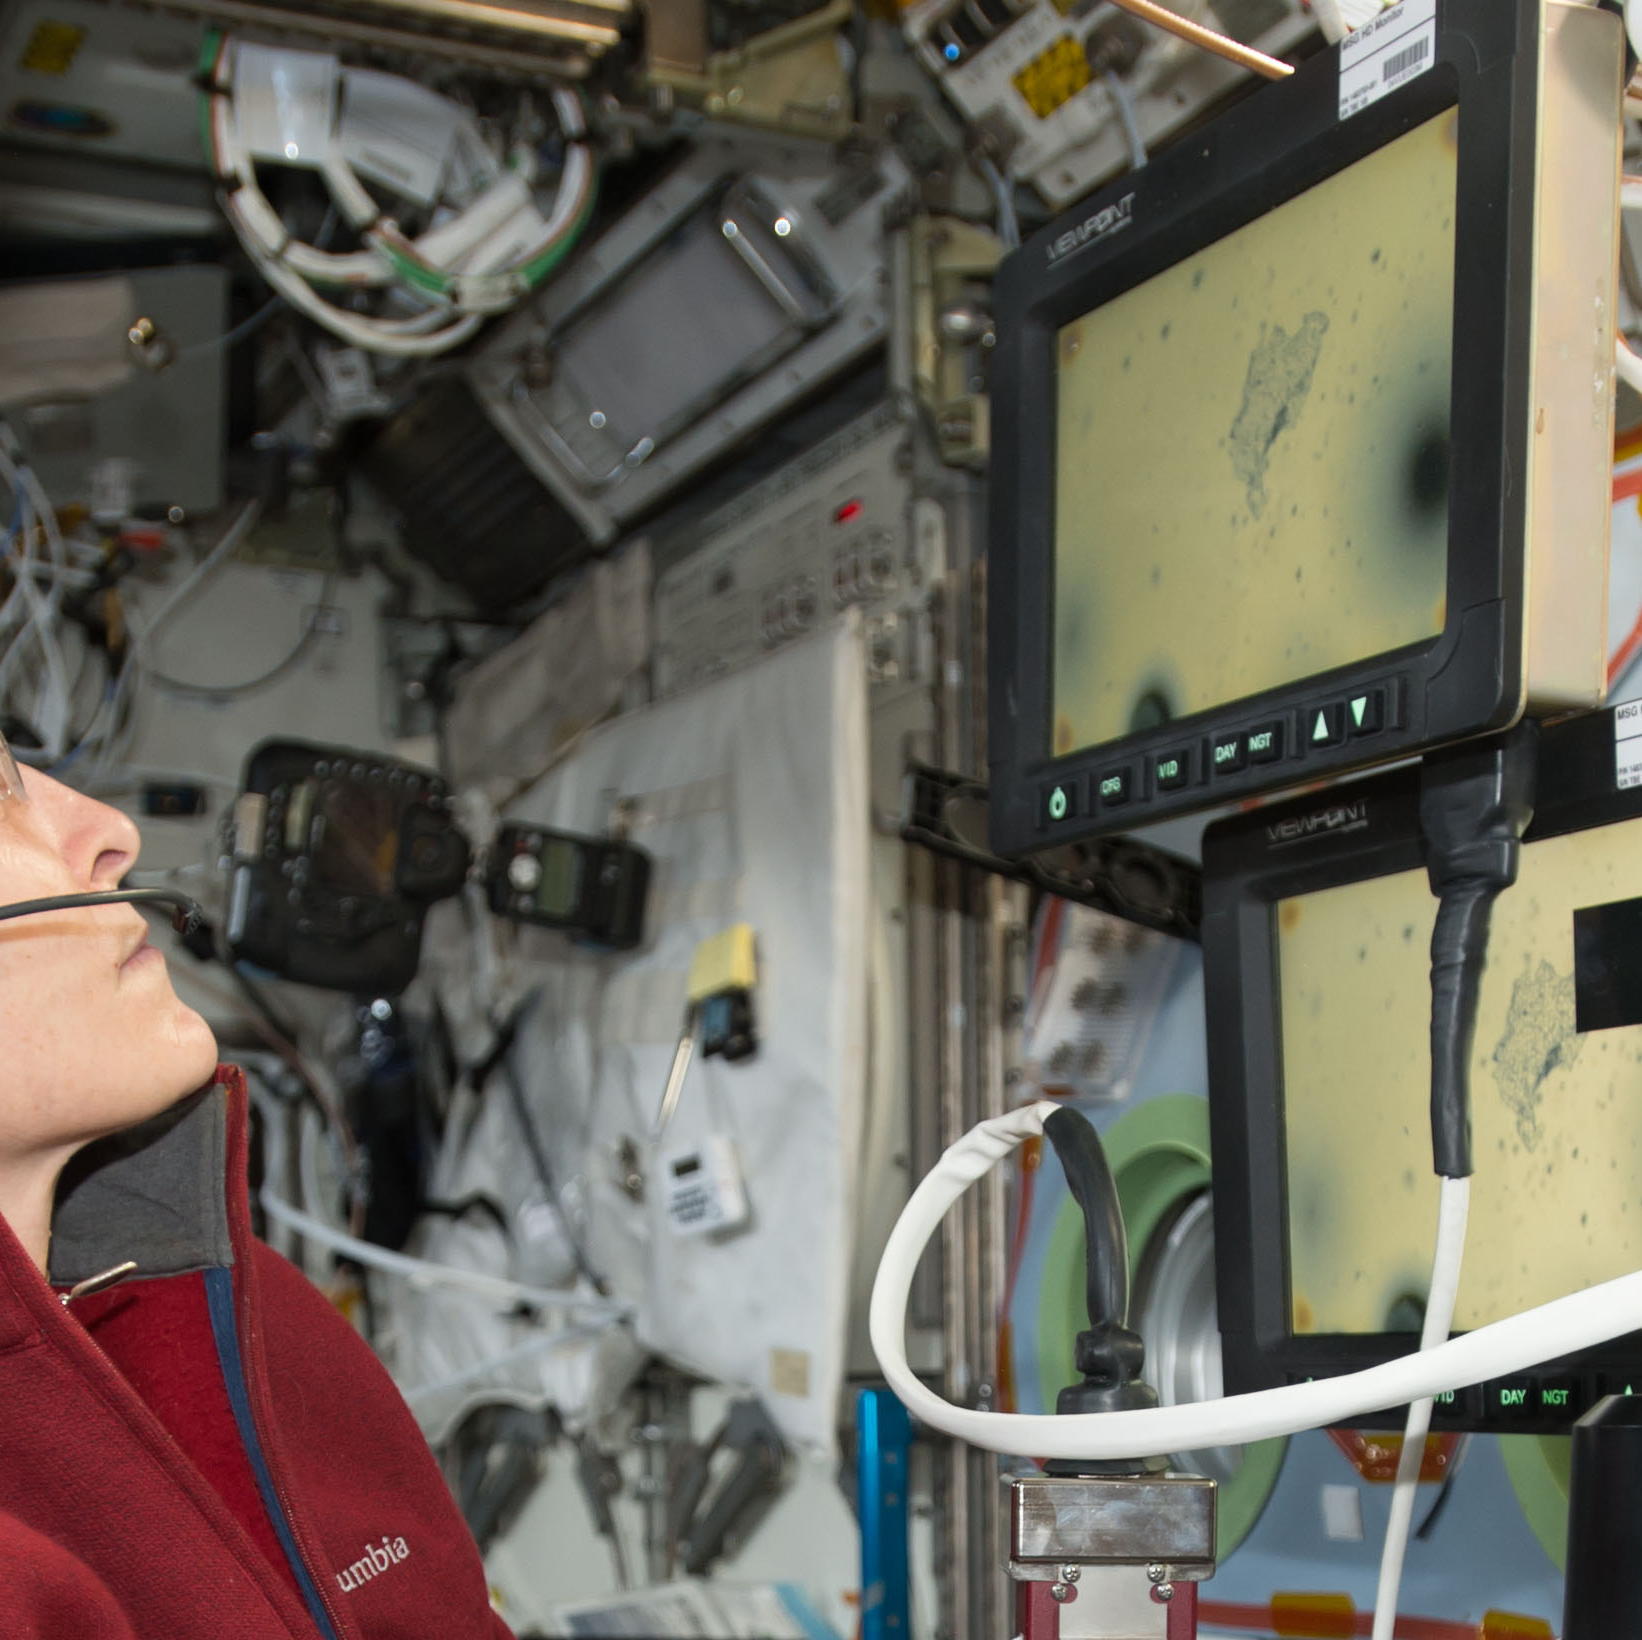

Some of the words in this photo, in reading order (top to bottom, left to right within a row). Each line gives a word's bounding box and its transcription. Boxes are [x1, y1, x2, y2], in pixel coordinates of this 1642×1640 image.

[1617, 705, 1638, 720] MSG
[1249, 731, 1272, 752] NGT
[1214, 742, 1238, 763] DAY
[1158, 760, 1178, 780] VID
[1500, 1388, 1526, 1405] DAY
[1542, 1389, 1569, 1405] NGT
[335, 1535, 410, 1593] umbia
